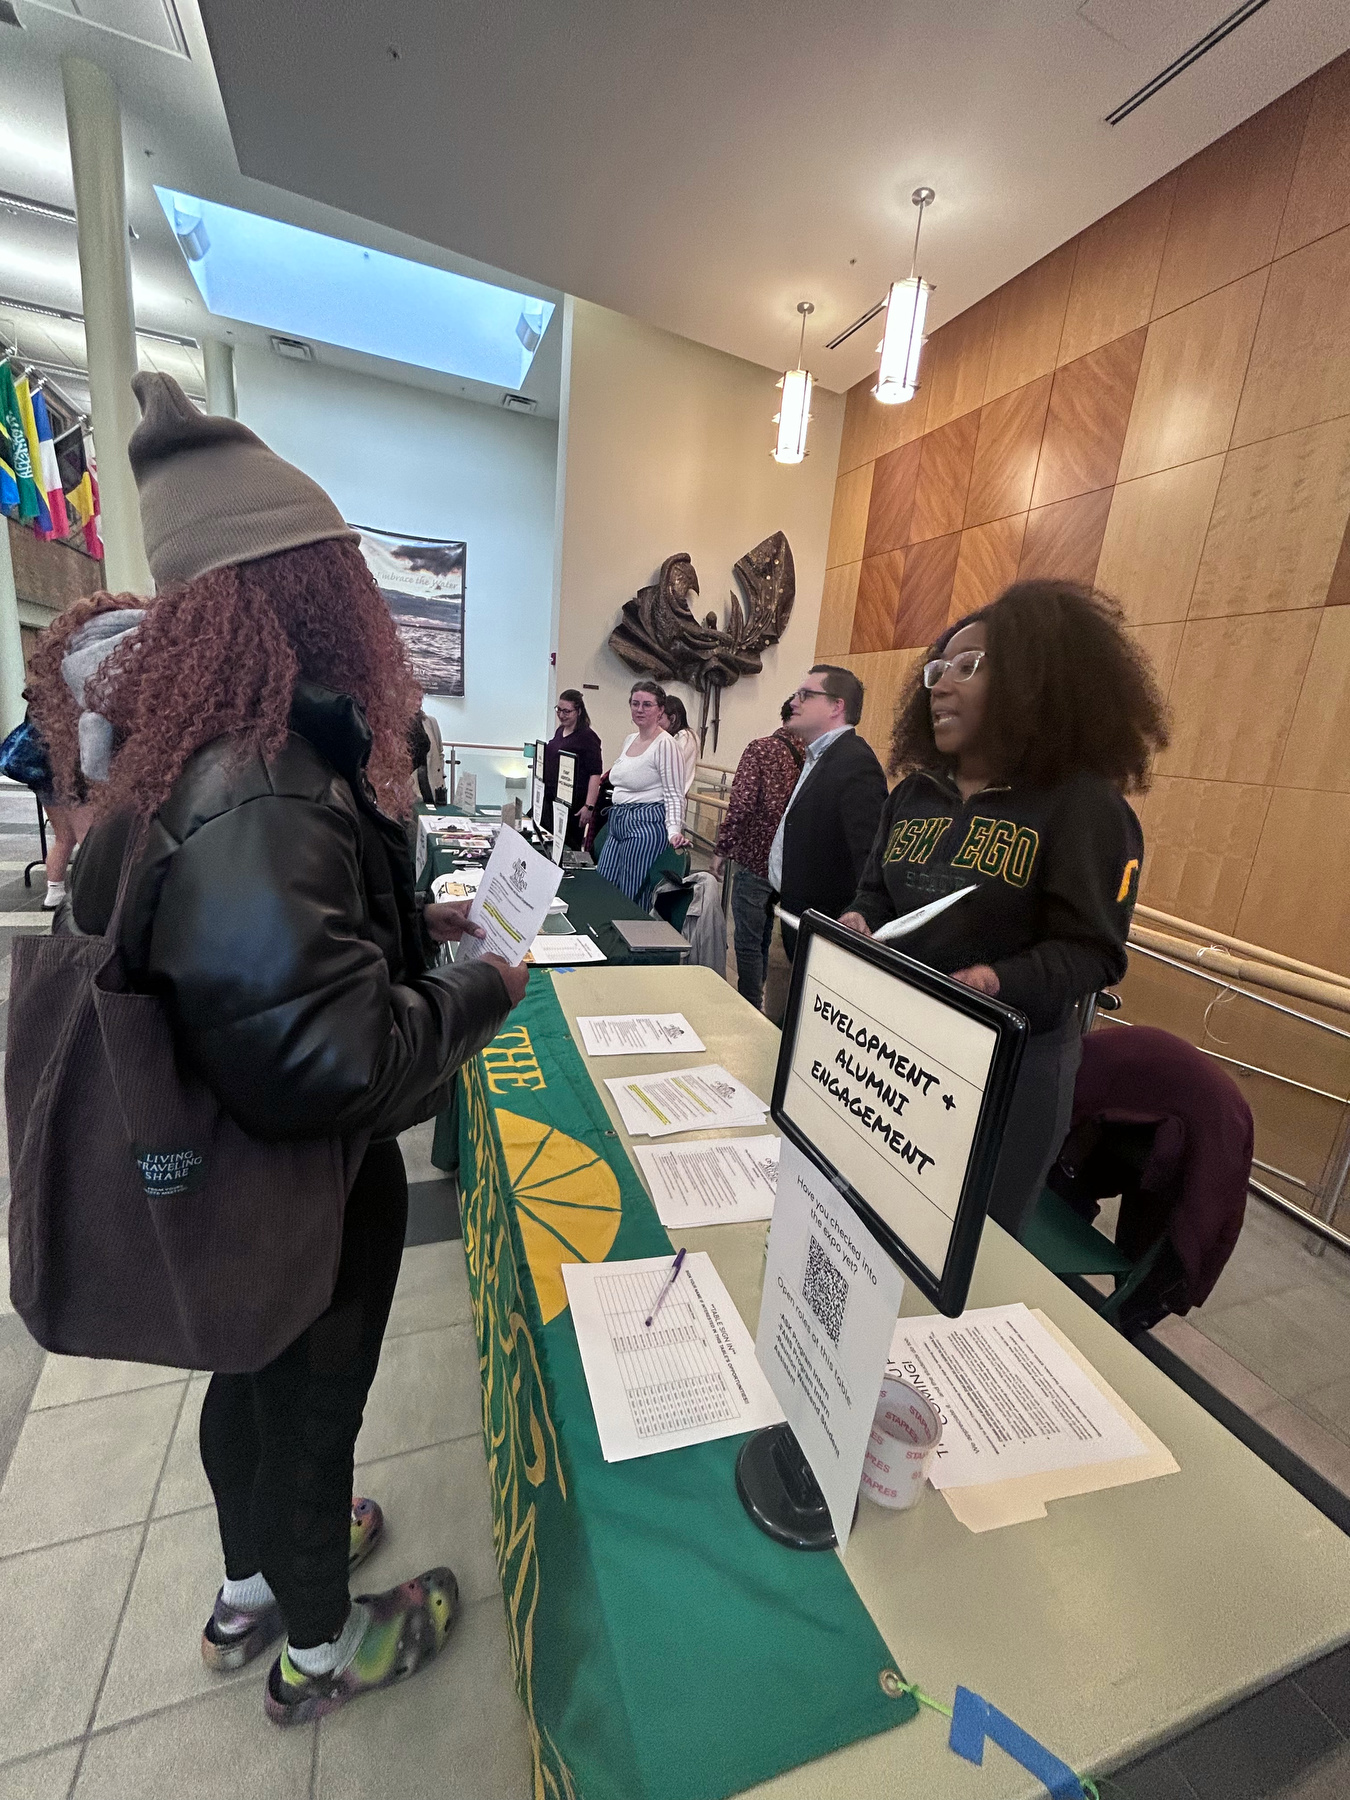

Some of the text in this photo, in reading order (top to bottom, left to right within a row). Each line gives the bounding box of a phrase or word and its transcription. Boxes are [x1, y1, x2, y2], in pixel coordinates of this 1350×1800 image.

[481, 1025, 547, 1094] THE
[813, 993, 941, 1096] DEVELOPMENT
[835, 1048, 910, 1117] ALUMNI
[811, 1060, 936, 1175] ENGAGEMENT
[145, 1167, 189, 1181] SHARE
[797, 1174, 877, 1285] Have you checked into
[810, 1208, 858, 1275] the expo yet?
[777, 1276, 795, 1307] Open
[795, 1306, 811, 1334] roles
[811, 1333, 819, 1348] at
[820, 1345, 833, 1371] this
